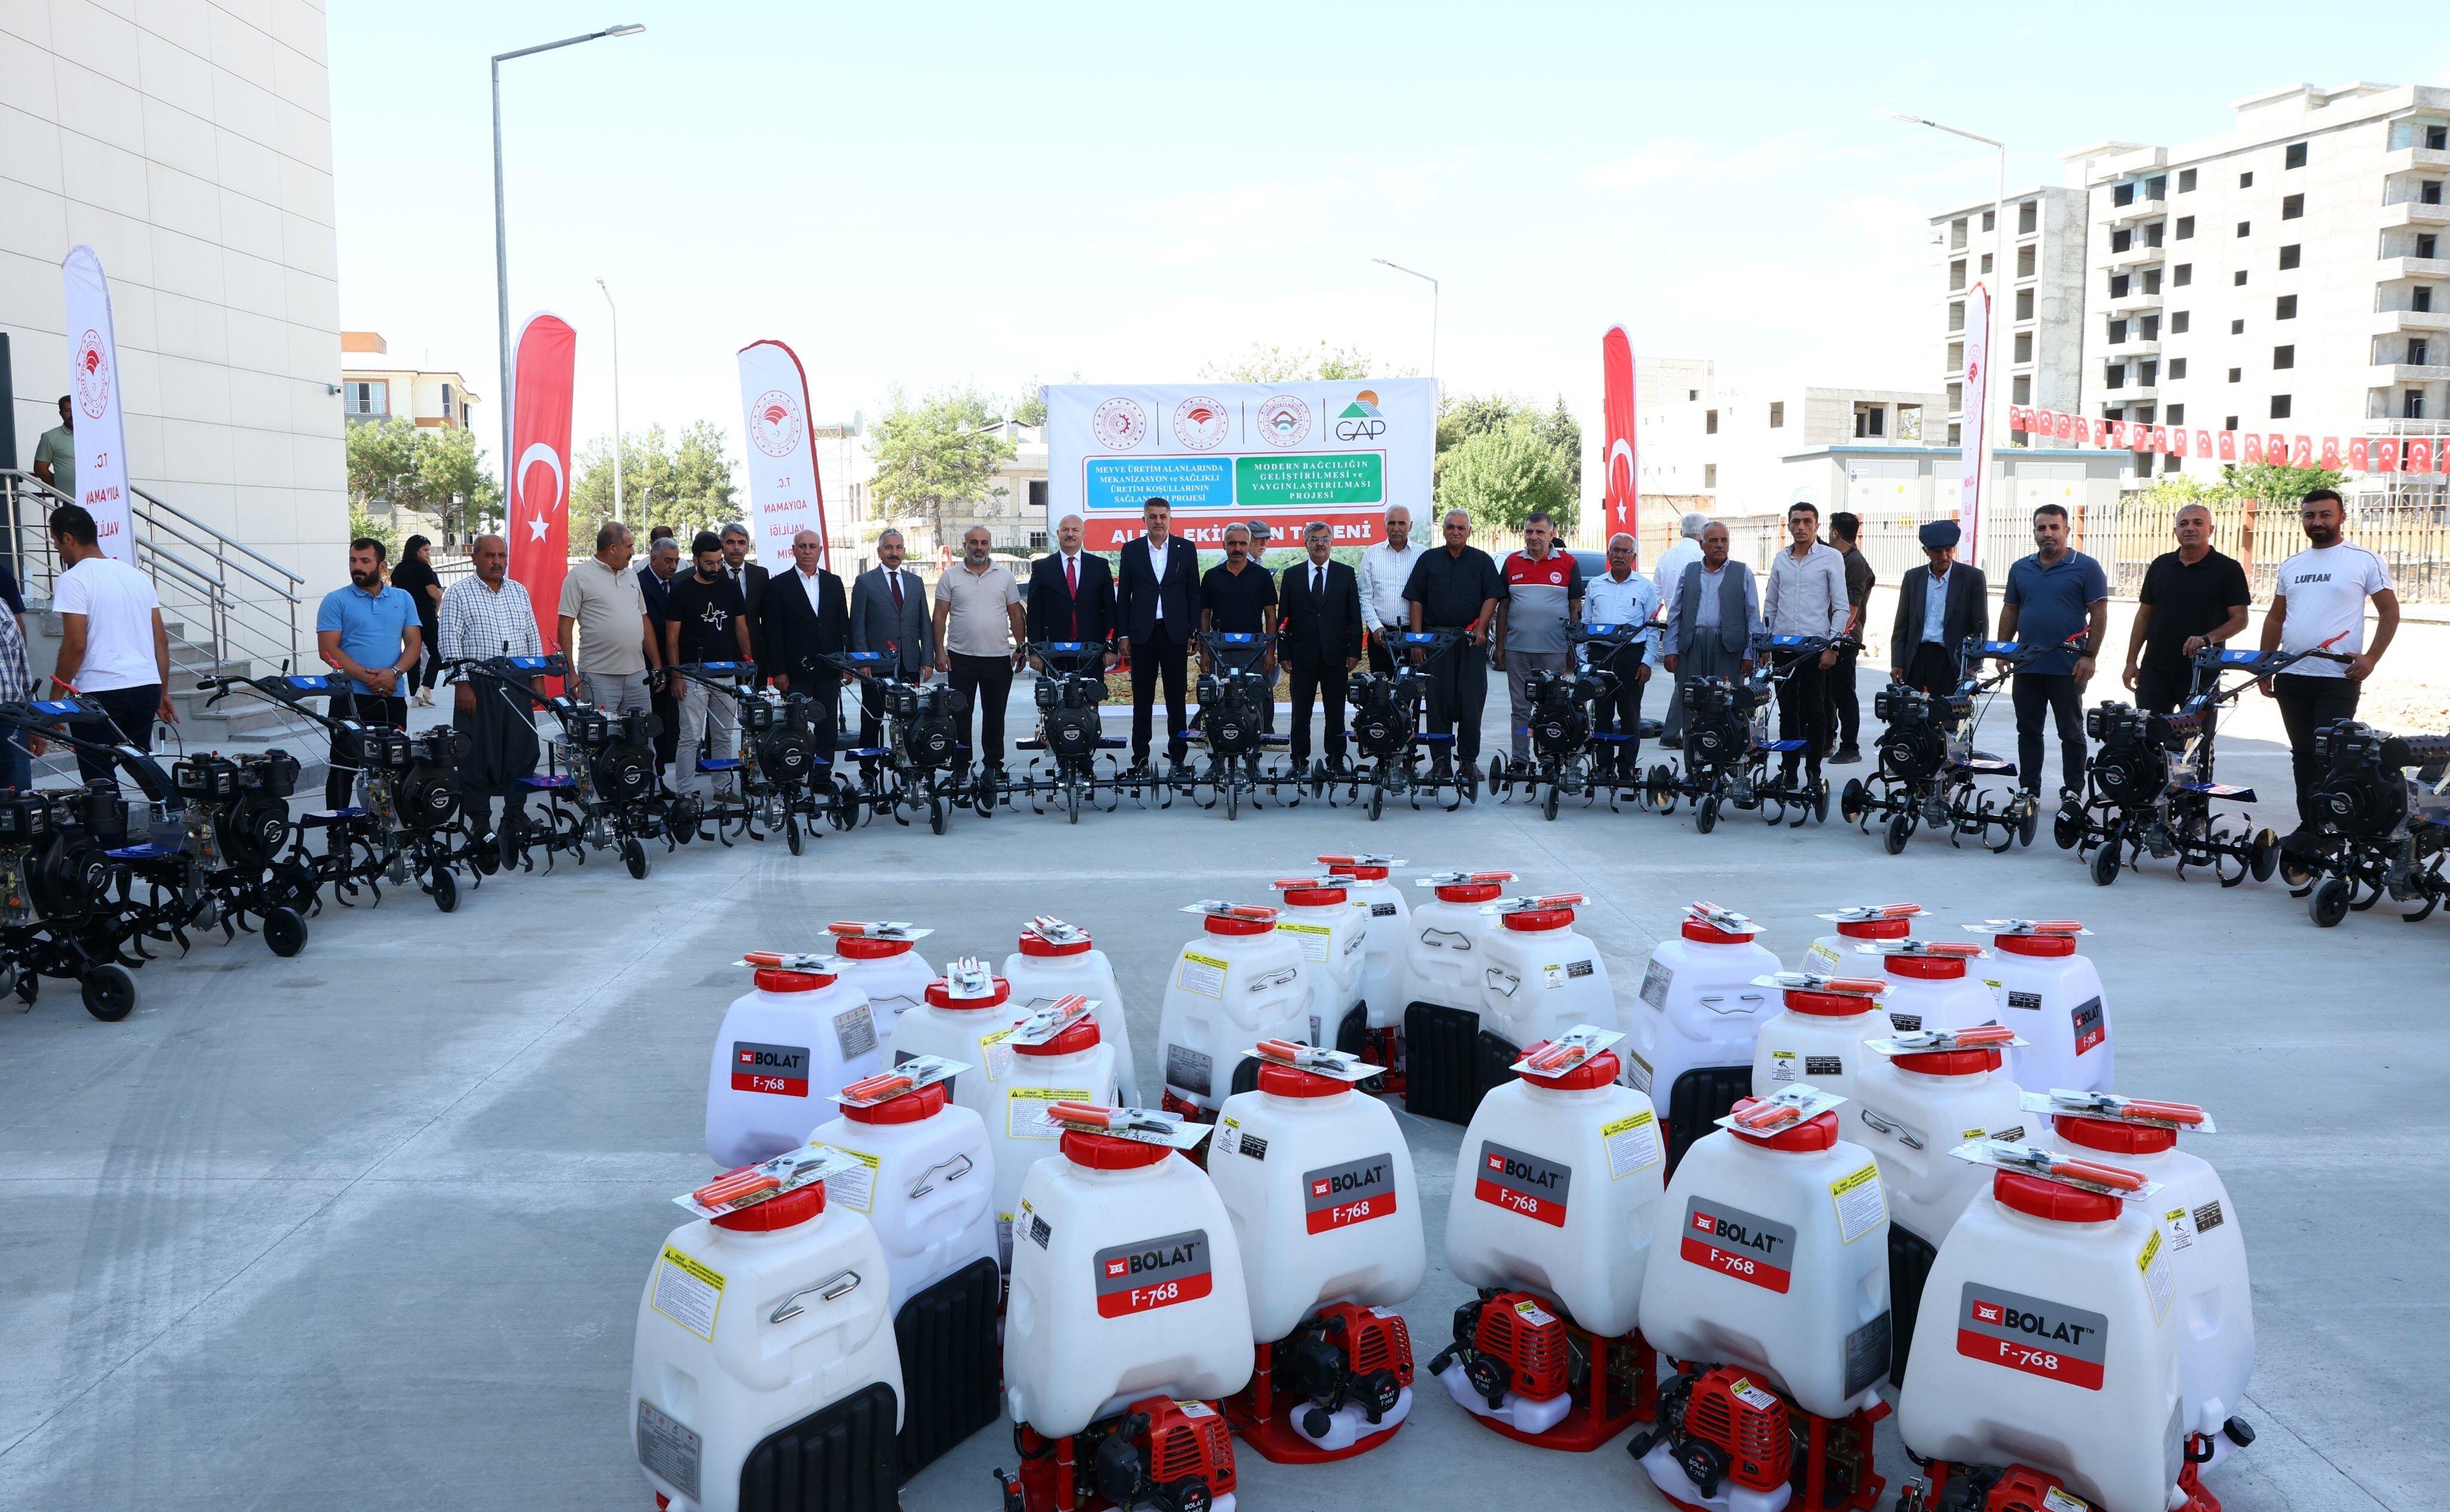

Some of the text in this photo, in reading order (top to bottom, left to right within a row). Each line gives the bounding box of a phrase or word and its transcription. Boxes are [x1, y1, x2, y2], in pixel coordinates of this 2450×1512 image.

[1336, 420, 1386, 441] GAP
[1128, 464, 1161, 472] ÜRETİM
[1303, 460, 1368, 470] BAĞCILIĞIN
[1100, 475, 1168, 483] MEKANİZASYON
[1179, 474, 1220, 482] SAĞLIKLI
[1260, 470, 1349, 481] GELİŞTİRİLMESİ
[1111, 484, 1209, 493] ÜRETİM KOŞULLARININ
[1252, 480, 1371, 490] YAYGINLAŞTIRILMASI
[1171, 493, 1206, 502] PROJESİ
[1290, 490, 1334, 499] PROJESİ
[2294, 573, 2332, 584] LUFIAN
[2083, 1031, 2096, 1048] F-768
[753, 1076, 785, 1092] F-768
[1116, 1132, 1169, 1144] CLASSIC
[1500, 1188, 1537, 1213] F-768
[1333, 1201, 1370, 1223] F-768
[1710, 1248, 1754, 1275] F-768
[1131, 1282, 1178, 1307] F-768
[2000, 1342, 2058, 1370] F-768
[1476, 1380, 1489, 1389] F-768
[1381, 1397, 1394, 1406] F-768
[1689, 1466, 1705, 1479] F-768
